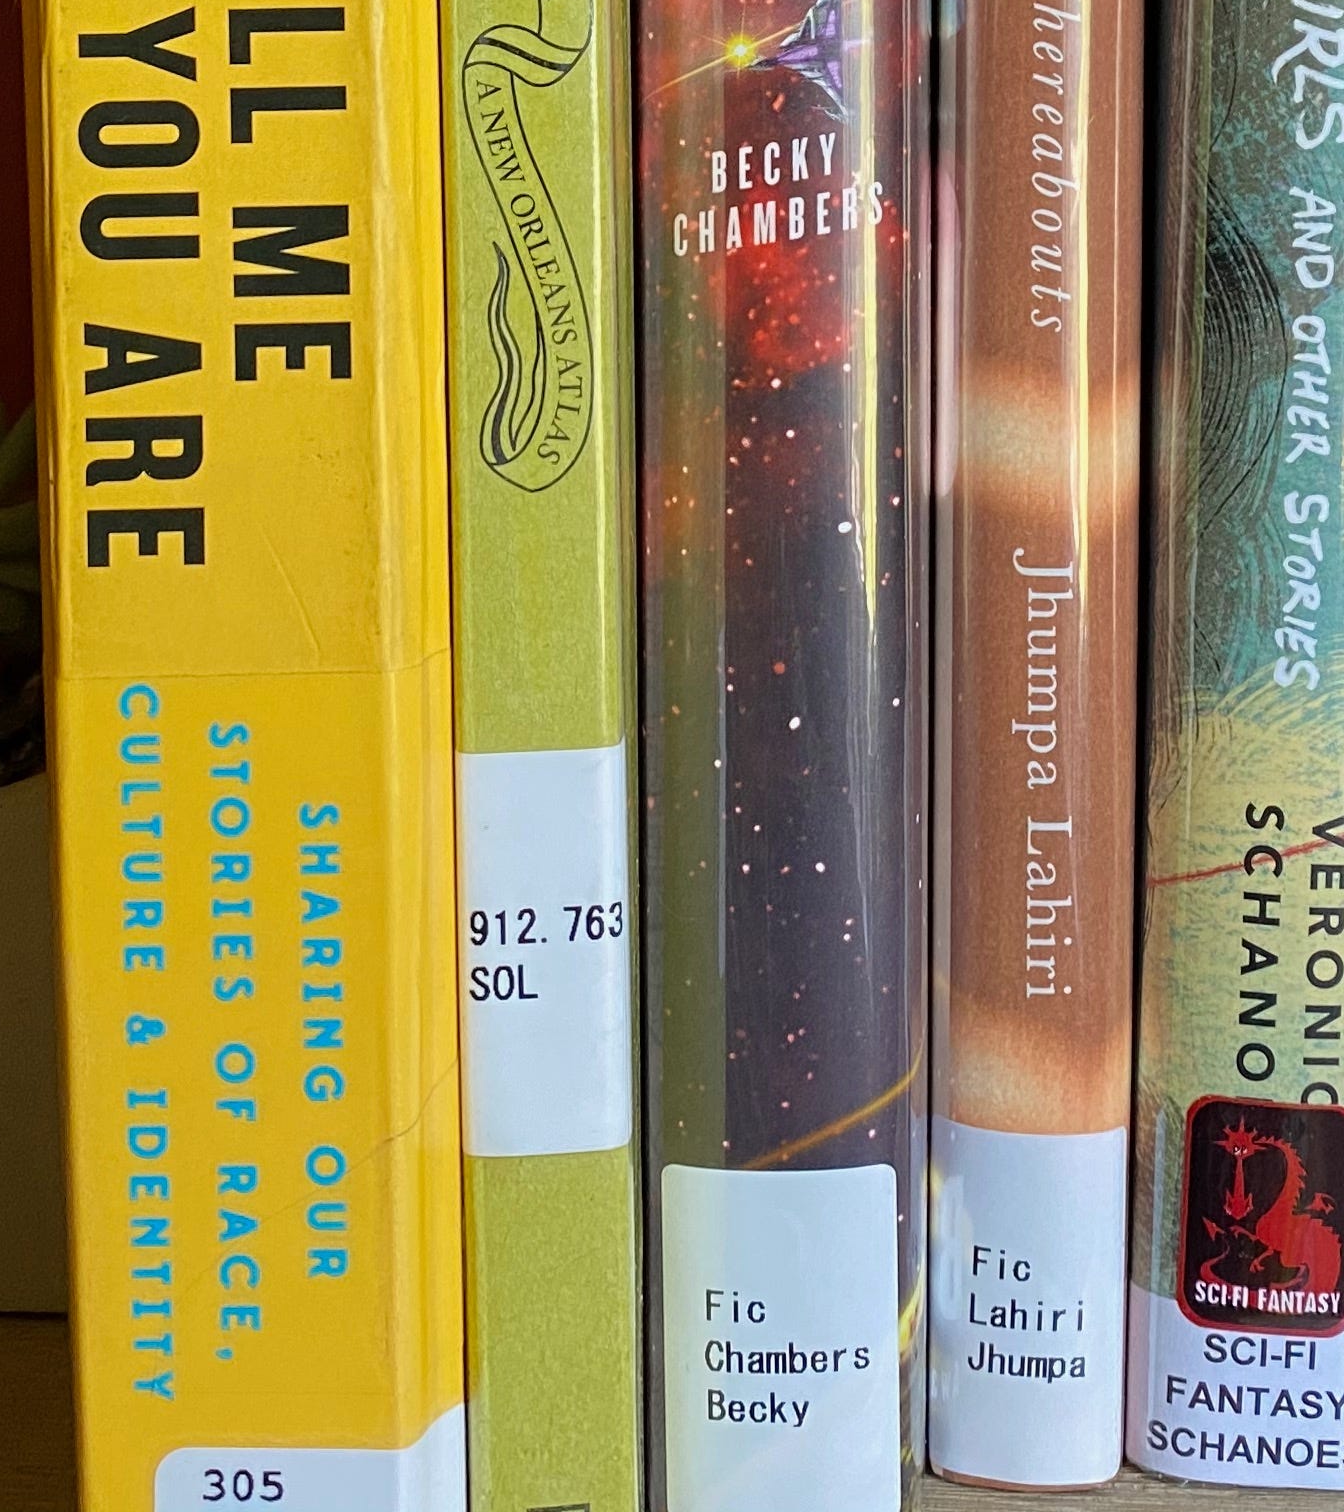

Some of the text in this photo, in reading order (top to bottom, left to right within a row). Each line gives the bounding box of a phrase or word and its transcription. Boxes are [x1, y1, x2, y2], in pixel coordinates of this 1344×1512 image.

[77, 6, 201, 261] YOU
[711, 131, 837, 194] BECKY
[673, 181, 884, 258] CHAMBERS
[1290, 187, 1337, 299] AND
[232, 204, 353, 381] ME
[475, 79, 583, 465] A NEW ORLEANS ATLAS
[1286, 315, 1331, 464] OTHER
[83, 323, 205, 567] ARE
[1273, 491, 1331, 691] STORIES
[1012, 548, 1074, 999] Jhumpa Lahiri
[469, 966, 538, 1003] SOL
[1236, 801, 1284, 1101] SCHANO
[119, 684, 175, 1401] CULTURE & IDENTITY
[208, 721, 262, 1361] STORIES OF RACE,
[299, 803, 349, 1280] SHARING OUR
[705, 1290, 767, 1325] Fic
[971, 1245, 1031, 1283] Fic
[1258, 1288, 1341, 1315] FANTASY
[704, 1340, 871, 1379] Chambers
[969, 1293, 1084, 1333] Lahiri
[1203, 1335, 1317, 1371] SCI-FI
[968, 1343, 1086, 1383] Jhumpa
[707, 1392, 810, 1429] Becky
[202, 1469, 285, 1502] 305
